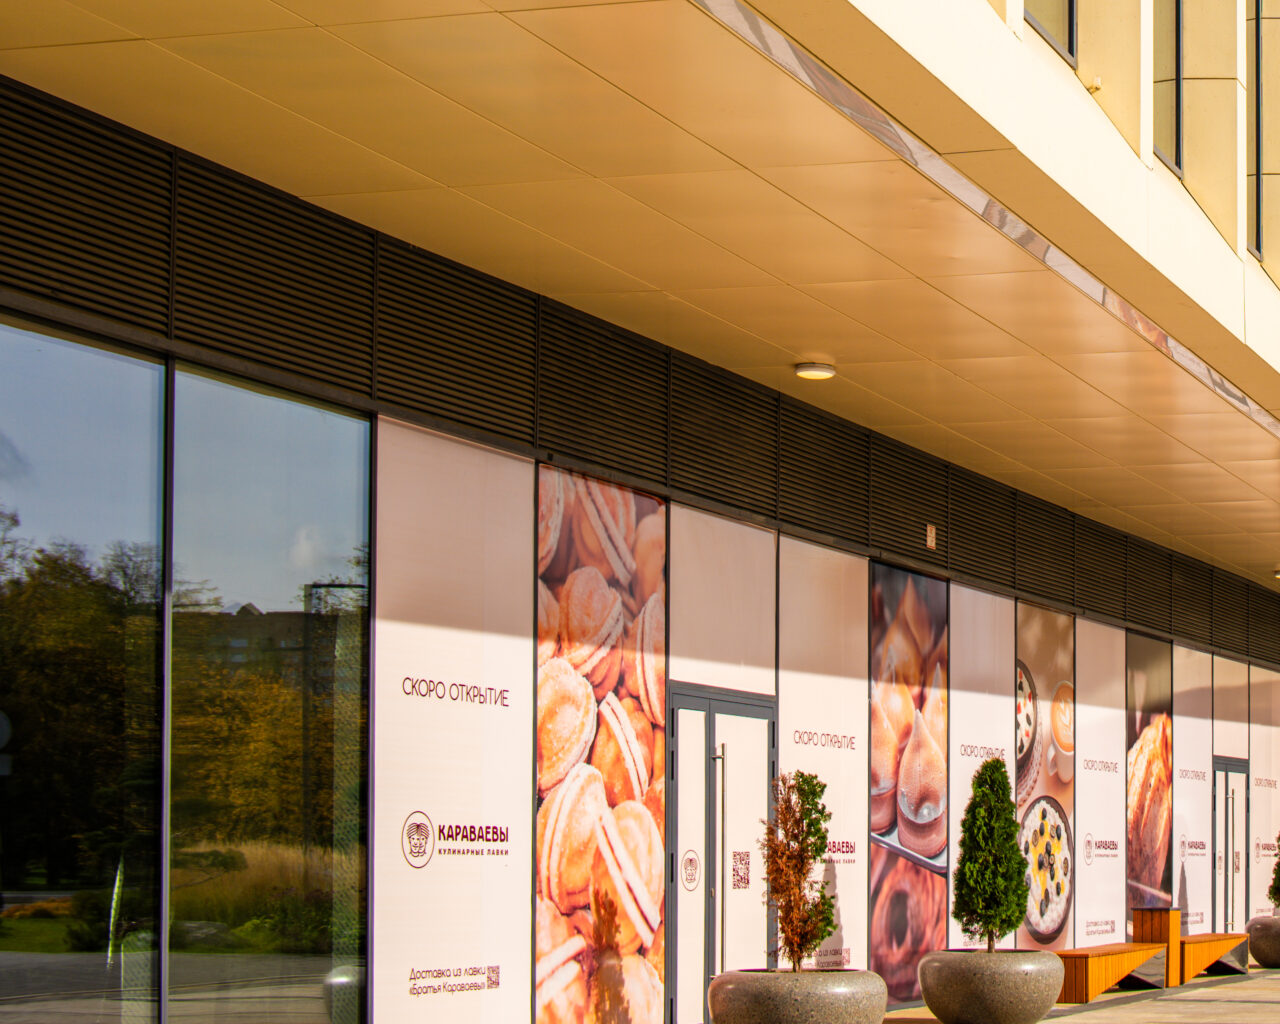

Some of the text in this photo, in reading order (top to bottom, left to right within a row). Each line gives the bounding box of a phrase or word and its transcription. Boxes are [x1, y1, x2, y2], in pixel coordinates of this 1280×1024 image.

[402, 676, 510, 707] СКОРО ОТКРЫТИЕ
[794, 730, 856, 751] СКОРО ОТКРЫТИЕ
[960, 744, 978, 758] СКОРО
[438, 824, 509, 843] КАРАВАЕВЫ
[438, 848, 509, 856] КУЛИНАРНЫЕ ЛАВКИ
[409, 966, 487, 981] Доставка из лавки
[409, 983, 442, 997] «Братья
